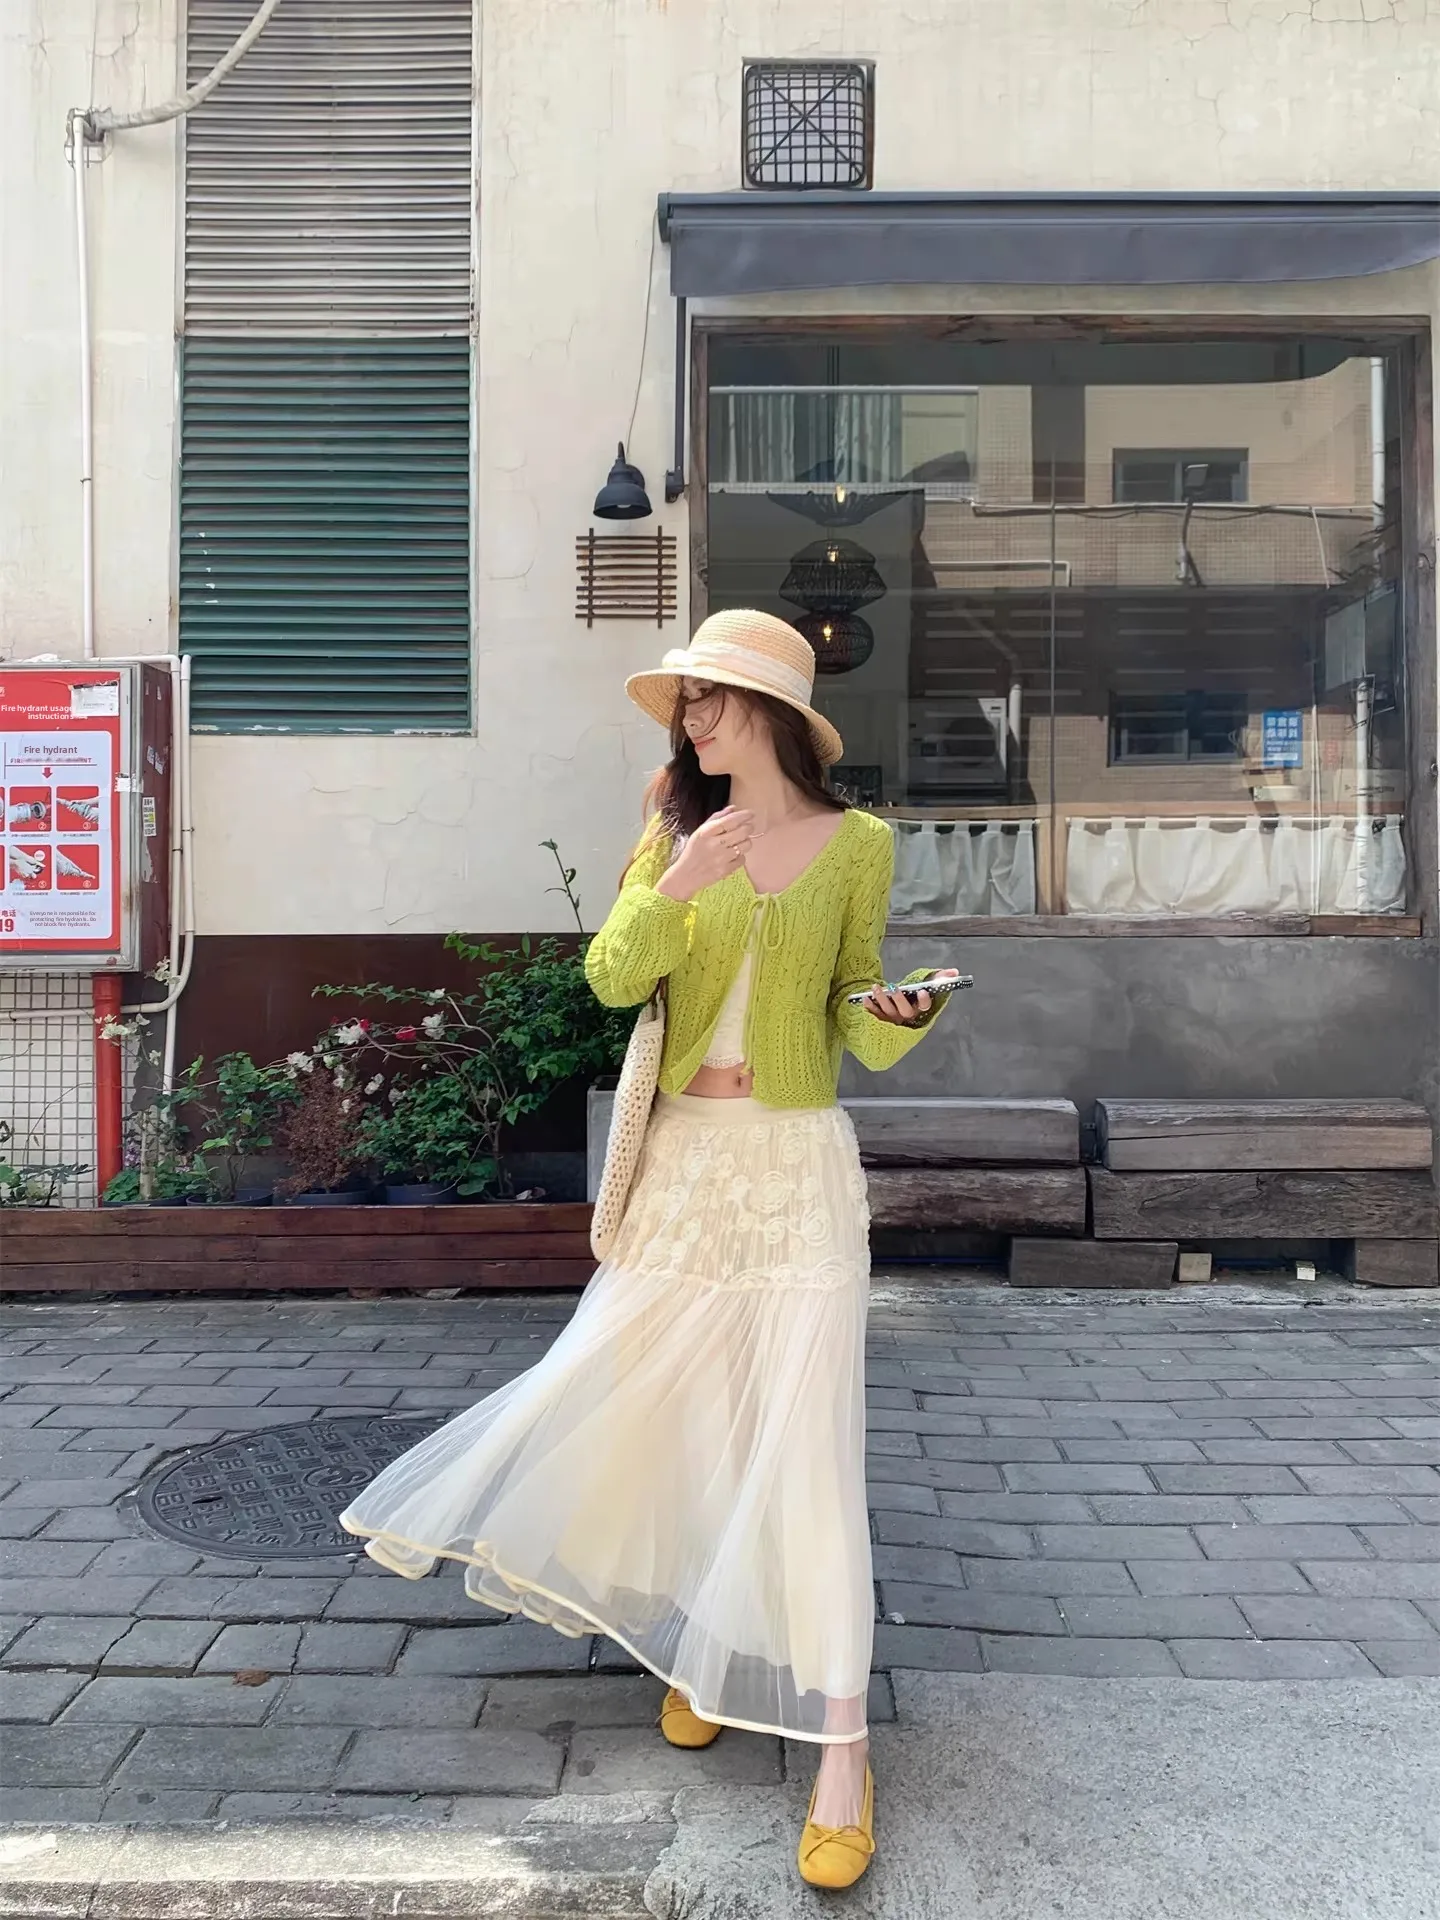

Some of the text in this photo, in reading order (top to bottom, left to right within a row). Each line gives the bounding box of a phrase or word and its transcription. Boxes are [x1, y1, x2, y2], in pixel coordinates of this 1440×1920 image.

[1, 704, 16, 712] Fire
[17, 704, 48, 713] hydrant
[24, 746, 78, 755] Fire hydrant
